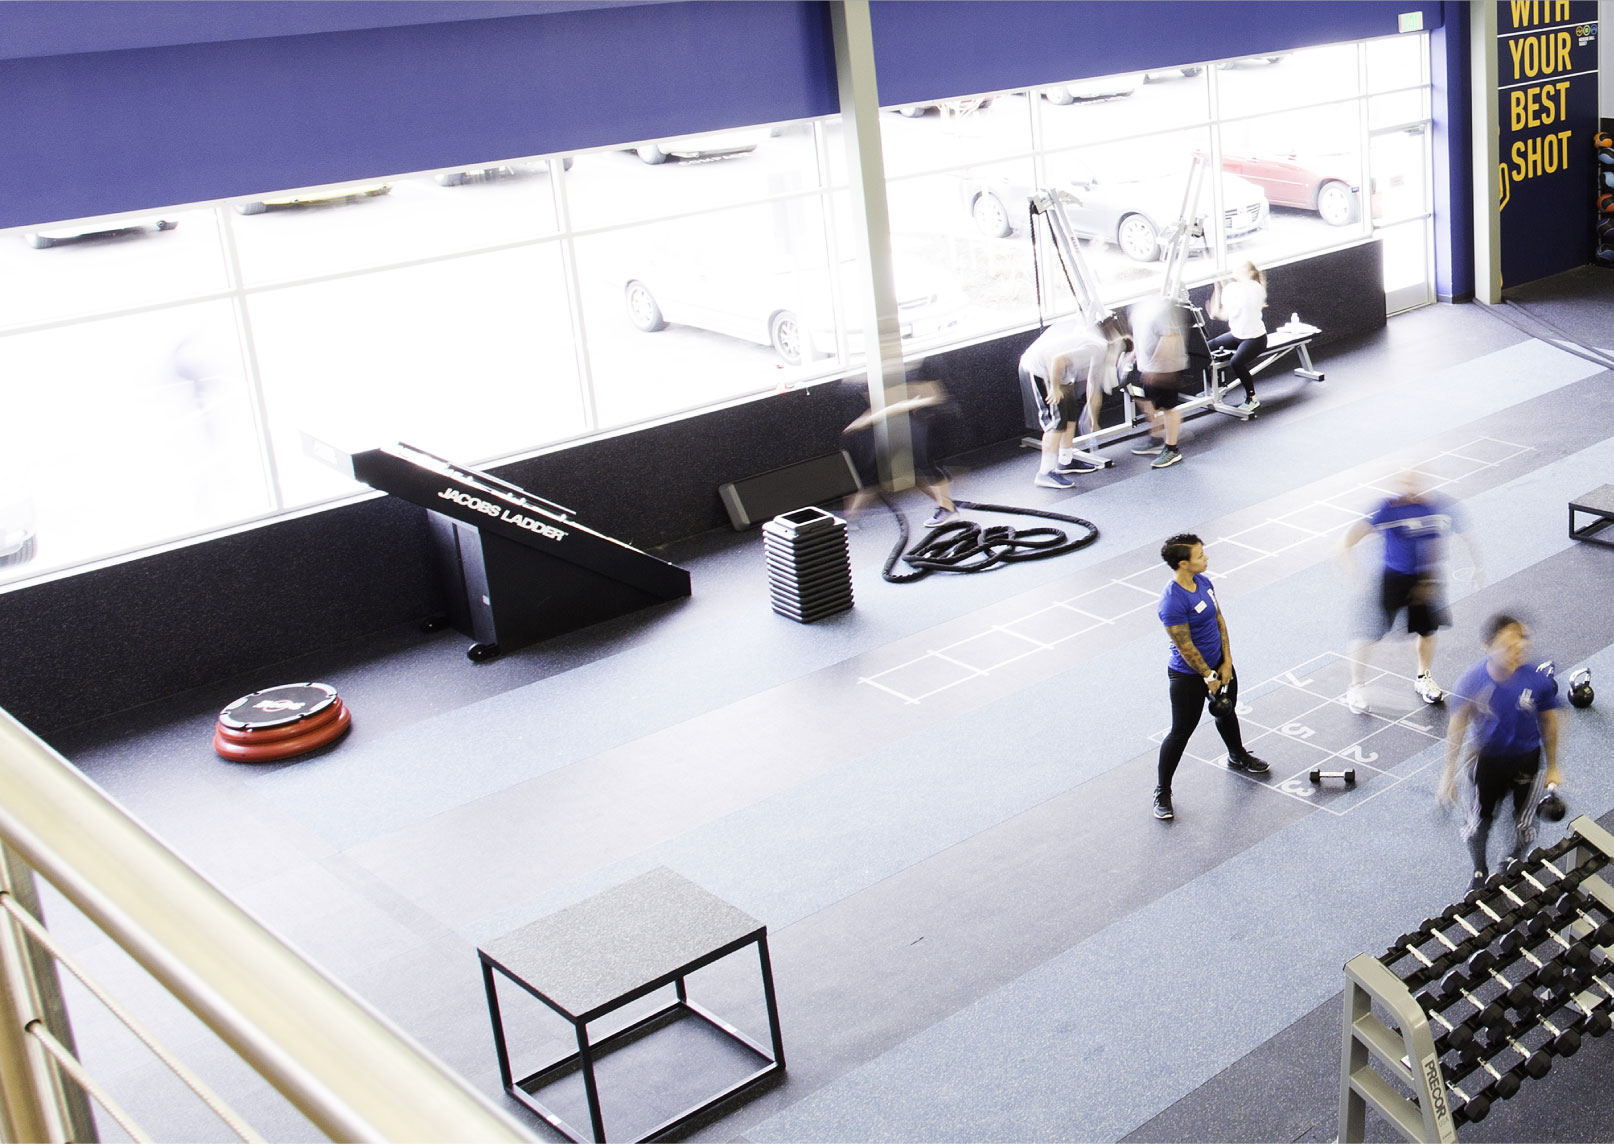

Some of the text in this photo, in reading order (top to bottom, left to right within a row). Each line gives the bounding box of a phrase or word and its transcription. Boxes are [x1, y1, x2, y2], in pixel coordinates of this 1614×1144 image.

[1508, 31, 1572, 80] YOUR
[1510, 81, 1571, 132] BEST
[1511, 130, 1572, 182] SHOT
[438, 488, 563, 542] JACOBS LADDER
[1281, 722, 1316, 739] 5
[1425, 1059, 1447, 1120] PRECOR
